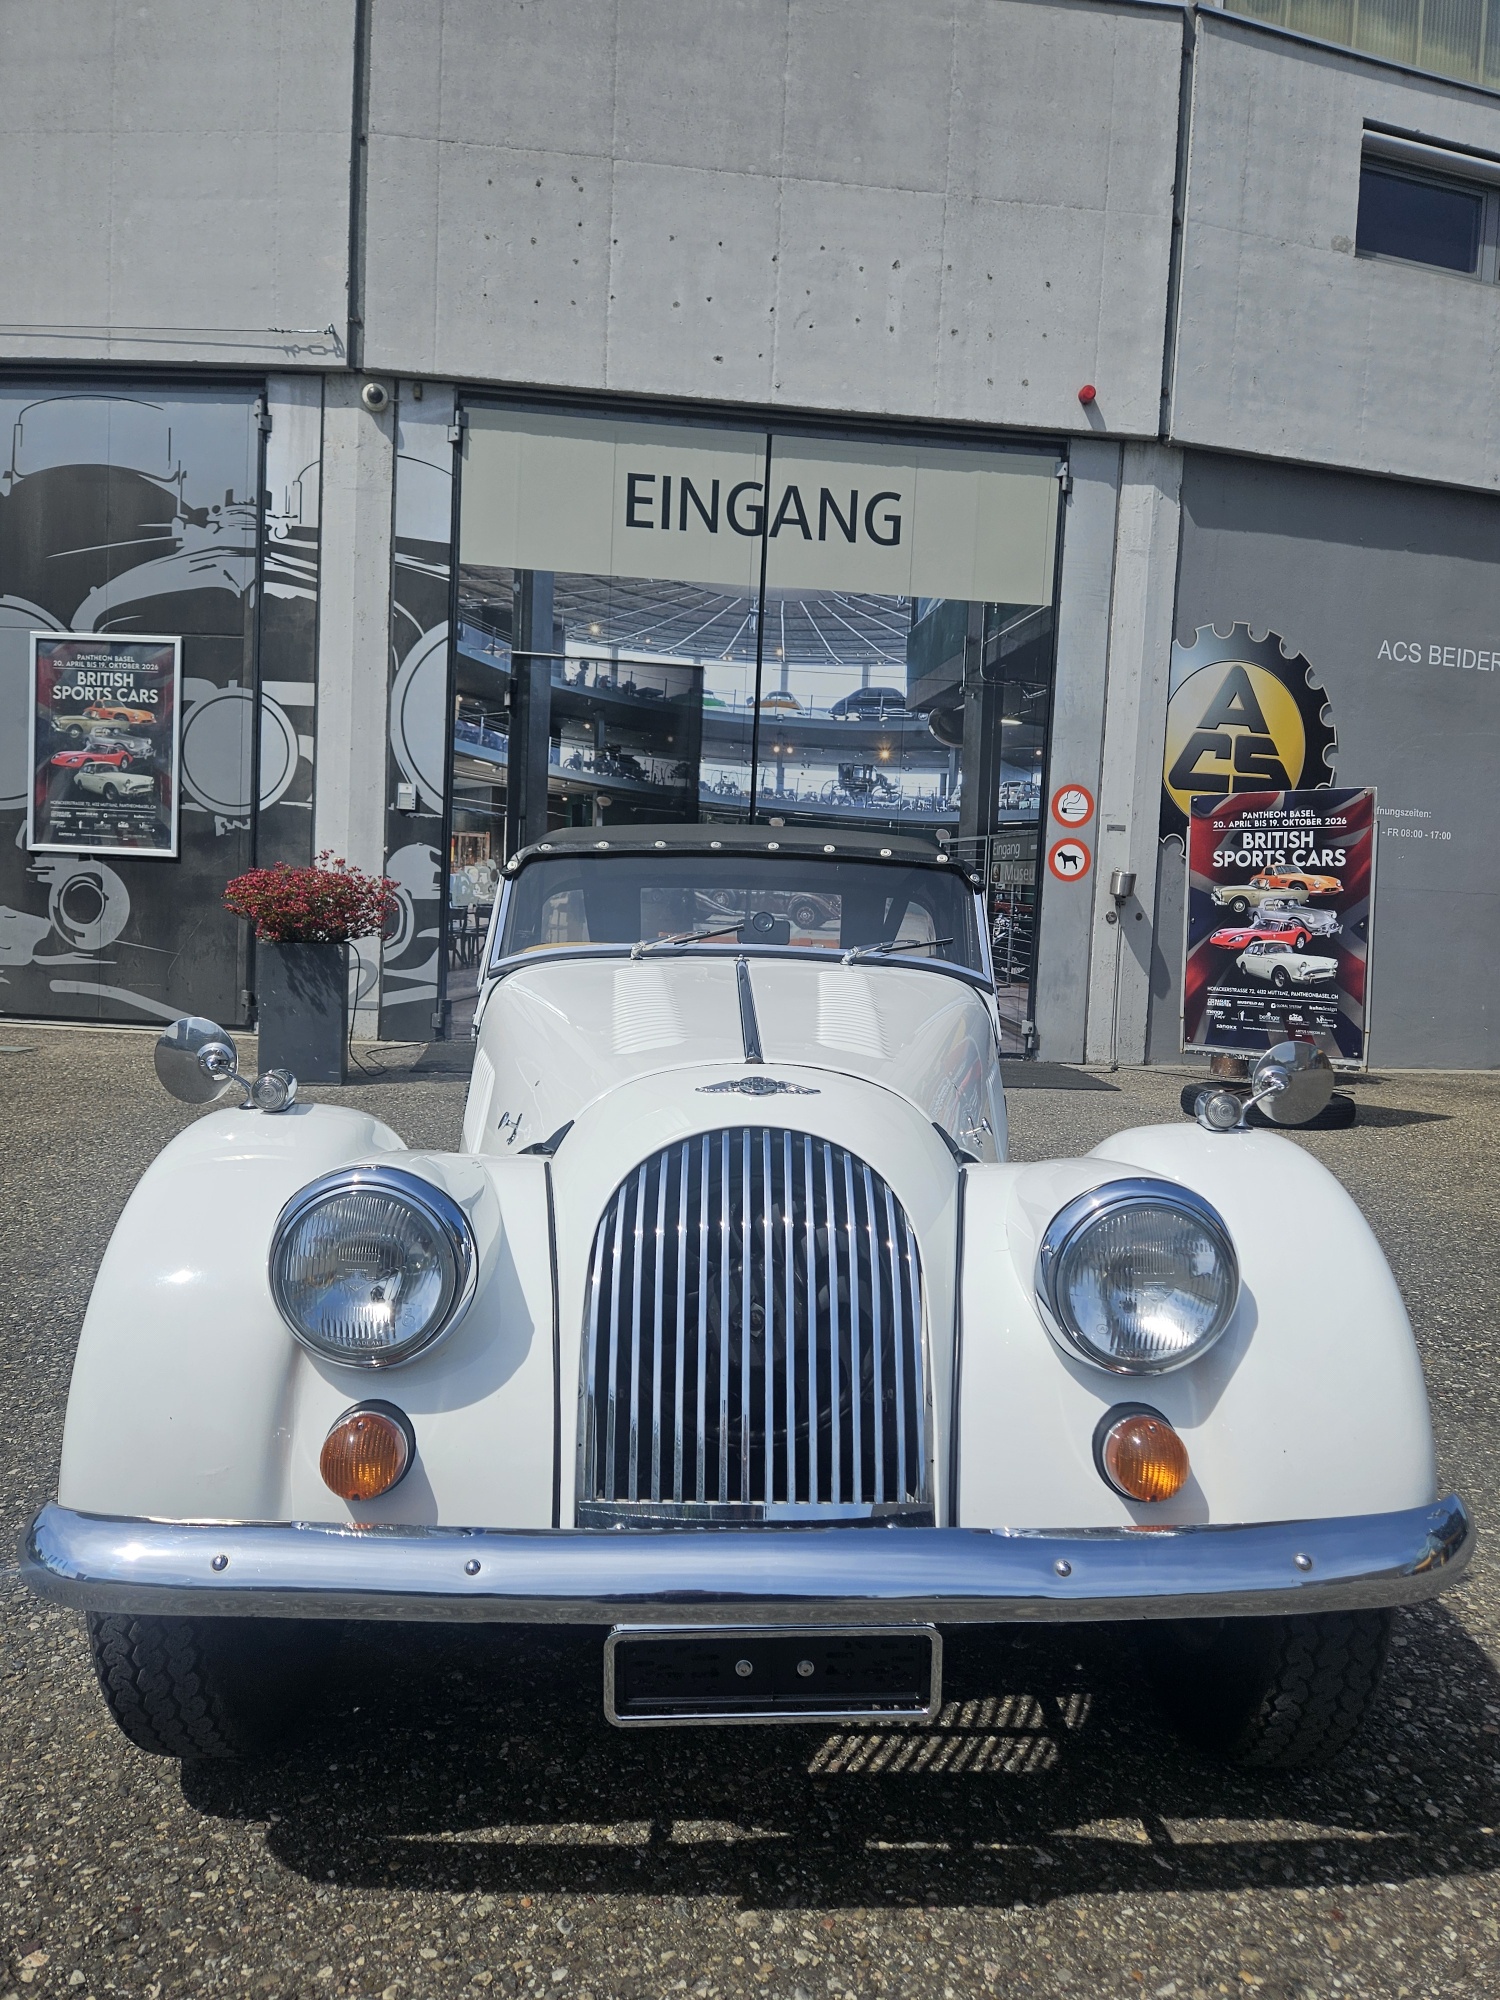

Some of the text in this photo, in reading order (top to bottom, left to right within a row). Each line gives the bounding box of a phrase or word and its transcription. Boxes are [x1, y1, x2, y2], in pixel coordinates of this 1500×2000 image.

[626, 472, 902, 546] EINGANG
[77, 654, 134, 663] PANTHEON BASEL
[1378, 639, 1500, 672] ACS BEIDER
[109, 662, 139, 670] OKTOBER
[77, 671, 134, 688] BRITISH
[52, 685, 158, 704] SPORTS CARS
[1168, 665, 1292, 793] ACS
[1242, 810, 1315, 819] PANTHEON BASEL
[1377, 806, 1431, 818] fnungszeiten:
[1213, 817, 1347, 828] 20. APRIL BIS 19. OKTOBER 2026
[1242, 831, 1314, 849] BRITISH
[1387, 828, 1399, 837] FR
[1400, 828, 1423, 839] 08:00
[1430, 830, 1452, 840] 17:00
[993, 842, 1021, 859] Eingang
[1213, 849, 1347, 868] SPORTS CARS
[1004, 865, 1035, 882] Museu
